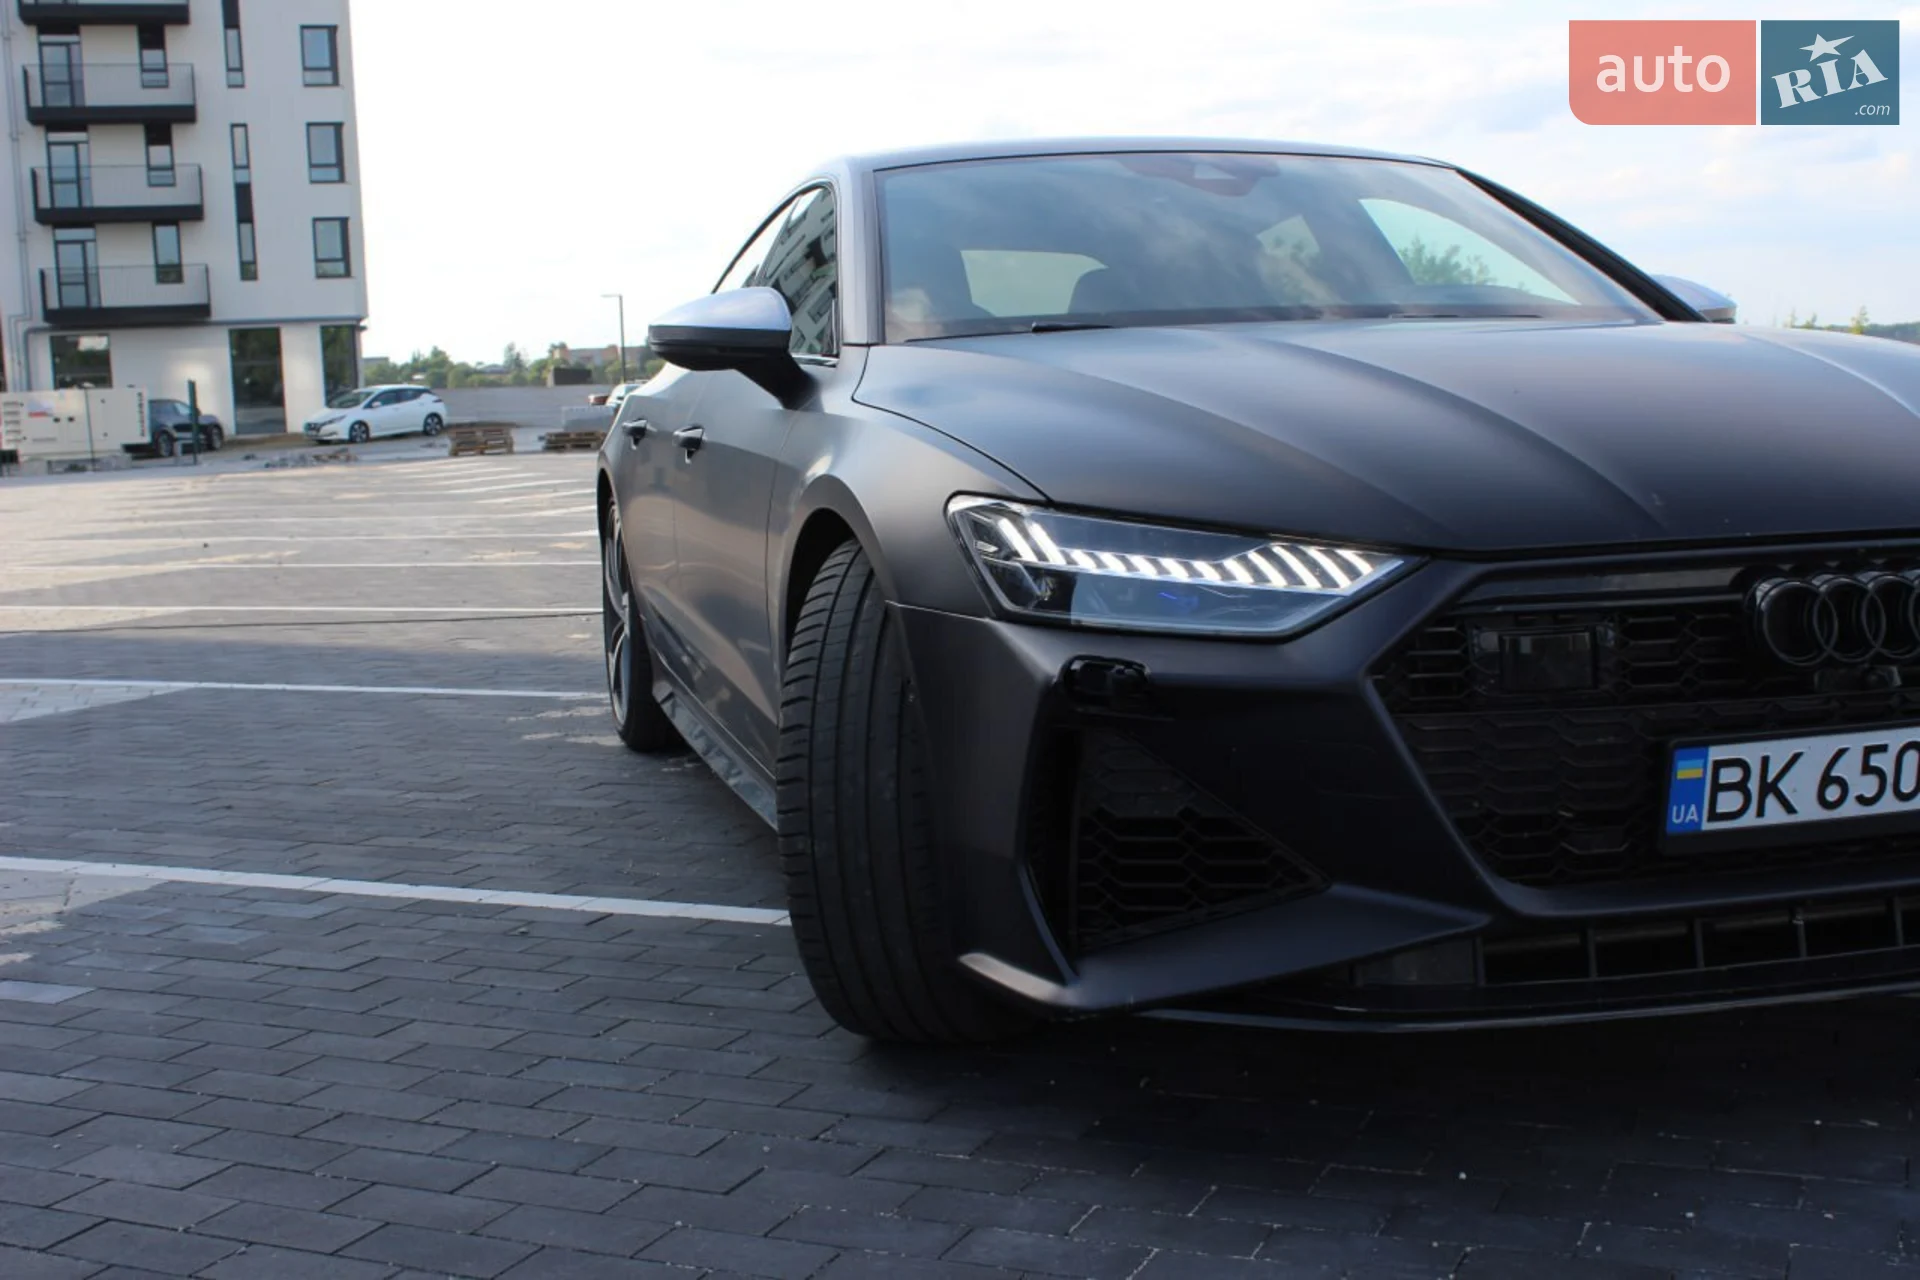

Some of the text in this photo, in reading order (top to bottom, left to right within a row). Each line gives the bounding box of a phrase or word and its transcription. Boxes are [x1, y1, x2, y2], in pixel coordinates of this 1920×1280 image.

[1706, 740, 1920, 823] BK 650
[1671, 803, 1699, 824] UA
